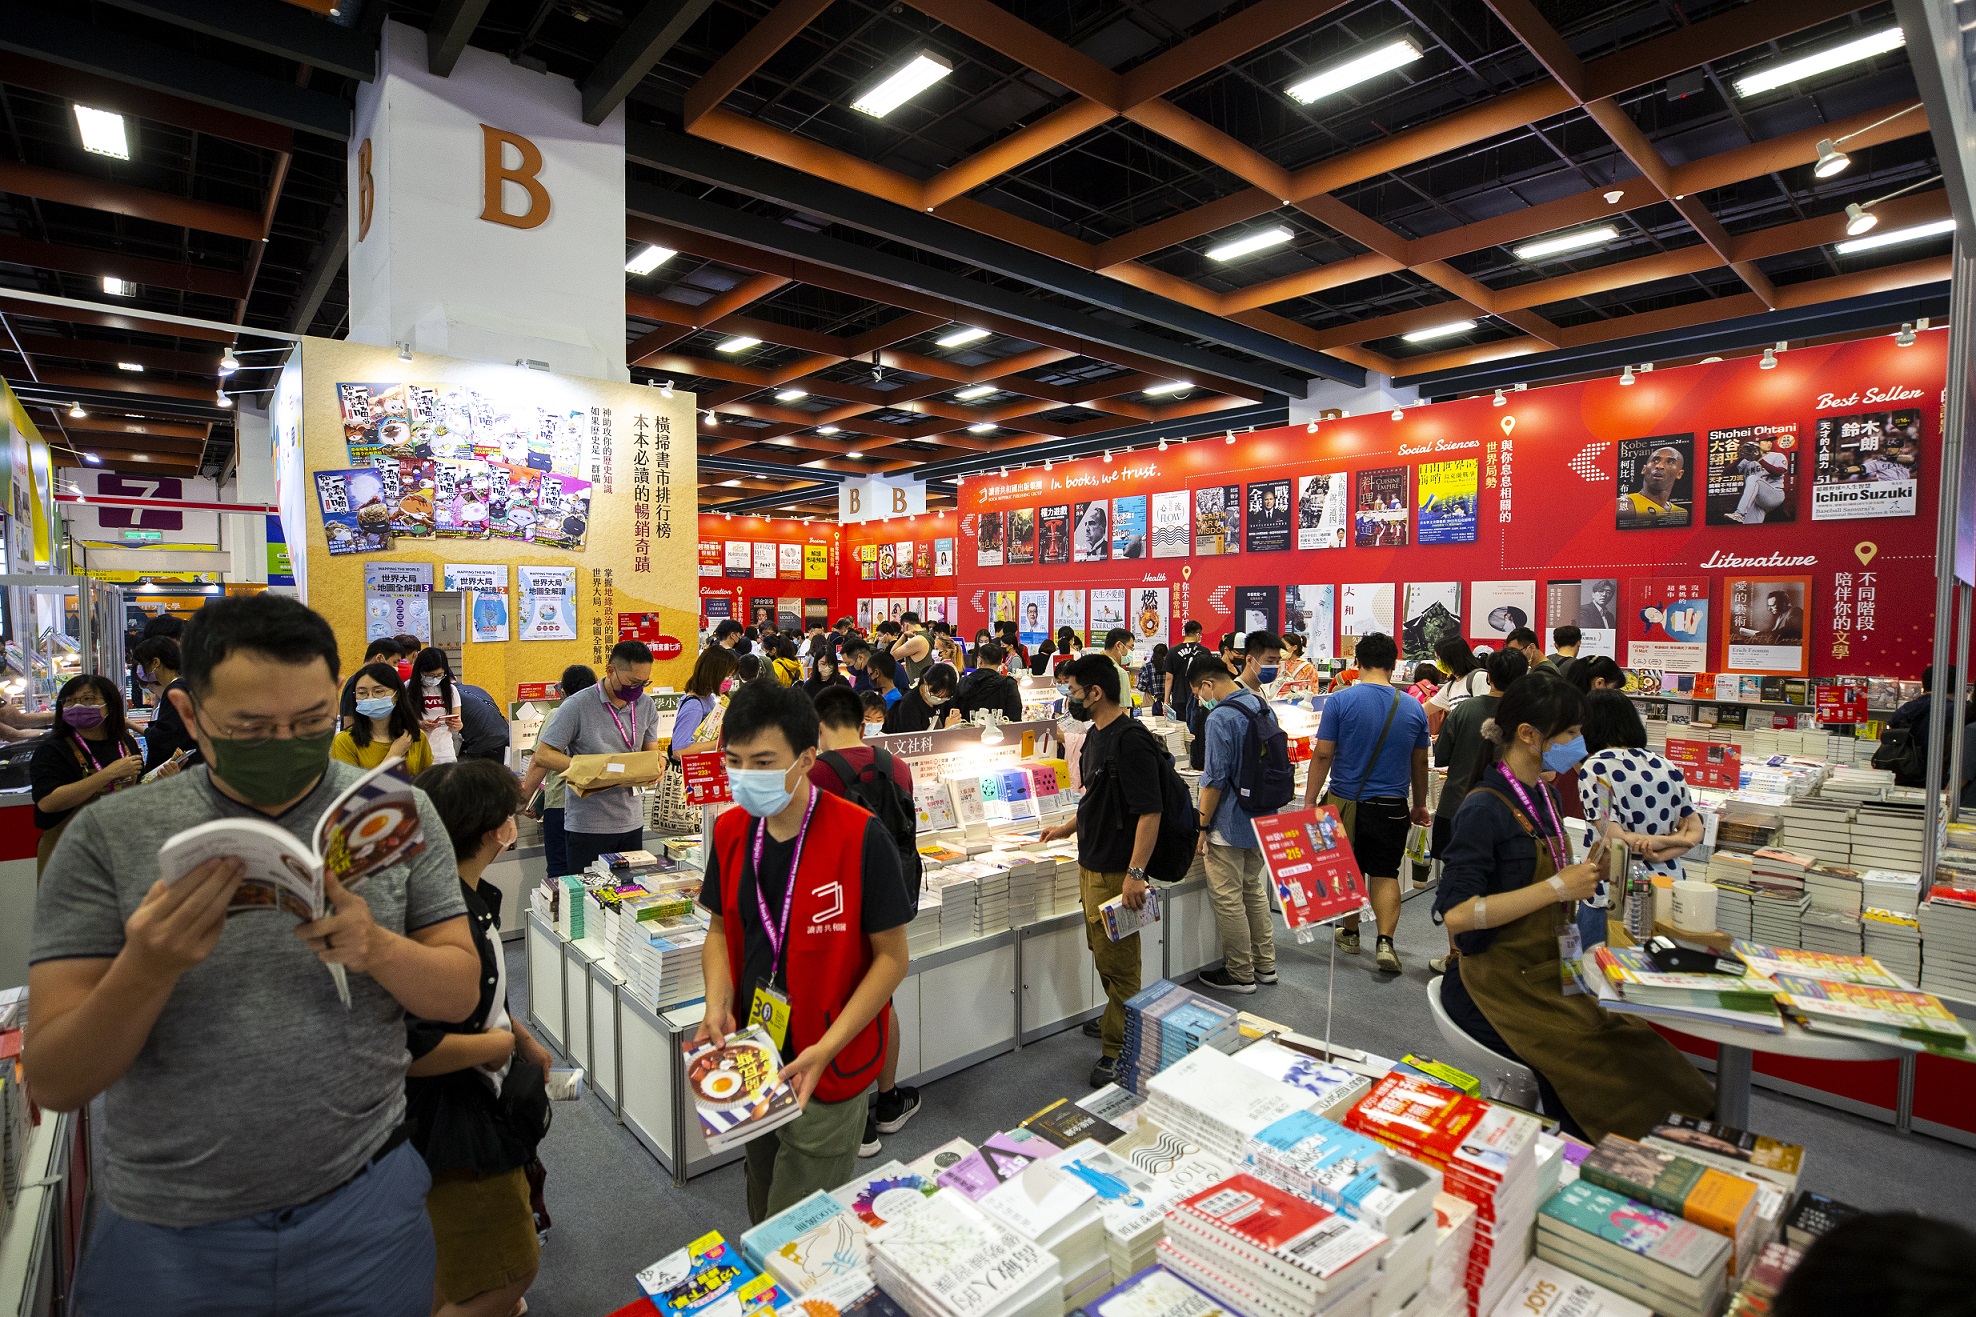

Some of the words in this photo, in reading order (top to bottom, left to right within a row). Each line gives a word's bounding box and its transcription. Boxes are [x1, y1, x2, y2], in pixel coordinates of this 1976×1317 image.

[479, 123, 550, 230] B
[358, 138, 374, 242] B
[1816, 392, 1860, 410] Best
[1862, 385, 1925, 404] Seller
[1709, 428, 1751, 440] Shohei
[1754, 423, 1797, 435] Ohtani
[1841, 420, 1880, 438] 鈴木
[590, 406, 601, 484] 如果歷史是一群喵
[602, 408, 613, 494] 神助攻你的歷史知識
[1397, 441, 1433, 456] Social
[1434, 439, 1480, 452] Sciences
[1621, 441, 1648, 450] Kobe
[1621, 448, 1653, 459] Bryant
[1709, 439, 1740, 453] 大谷
[1819, 421, 1831, 469] 天才的人間力
[1840, 436, 1879, 452] 一朗
[1485, 442, 1498, 489] 世界局勢
[1709, 452, 1739, 466] 翔平
[655, 416, 671, 539] 橫掃書市排行榜
[1050, 478, 1062, 491] In
[1065, 473, 1100, 489] books,
[1102, 471, 1119, 484] we
[1121, 463, 1162, 481] trust.
[1500, 439, 1513, 523] 與你息息相關的
[1709, 475, 1744, 483] 天才二刀流
[1816, 475, 1831, 485] 51
[121, 478, 160, 525] 7
[633, 413, 651, 574] 本本必讀的暢銷奇蹟
[850, 488, 861, 514] B
[892, 488, 907, 513] B
[1248, 488, 1263, 513] 全球
[1274, 485, 1290, 511] 戰場
[1816, 491, 1859, 503] Ichiro
[1860, 487, 1913, 500] Suzuki
[1160, 514, 1181, 523] FLOW
[1700, 550, 1819, 569] Literature
[377, 583, 422, 592] 地圖全解讀
[423, 584, 430, 592] 3
[381, 574, 417, 583] 世界大局
[460, 577, 493, 586] 世界大局
[532, 578, 563, 587] 世界大局
[1142, 573, 1166, 583] Health
[528, 587, 566, 596] 地圖全解讀
[700, 586, 732, 595] Education
[1092, 590, 1125, 599] 天生不愛動
[1666, 584, 1675, 598] 超市
[1678, 584, 1687, 605] 媽媽的
[1734, 580, 1748, 627] 愛的藝術
[1855, 572, 1877, 642] 不同階段，
[1832, 571, 1853, 660] 陪伴你的文學
[883, 736, 933, 755] 人文社科
[1285, 847, 1302, 861] 215
[807, 923, 847, 934] 讀書共和國
[998, 1153, 1032, 1179] BTS
[1291, 1151, 1323, 1174] KINGS
[1305, 1165, 1321, 1180] OF
[952, 1245, 1038, 1311] 高敏人的
[1523, 1279, 1557, 1314] JOYS
